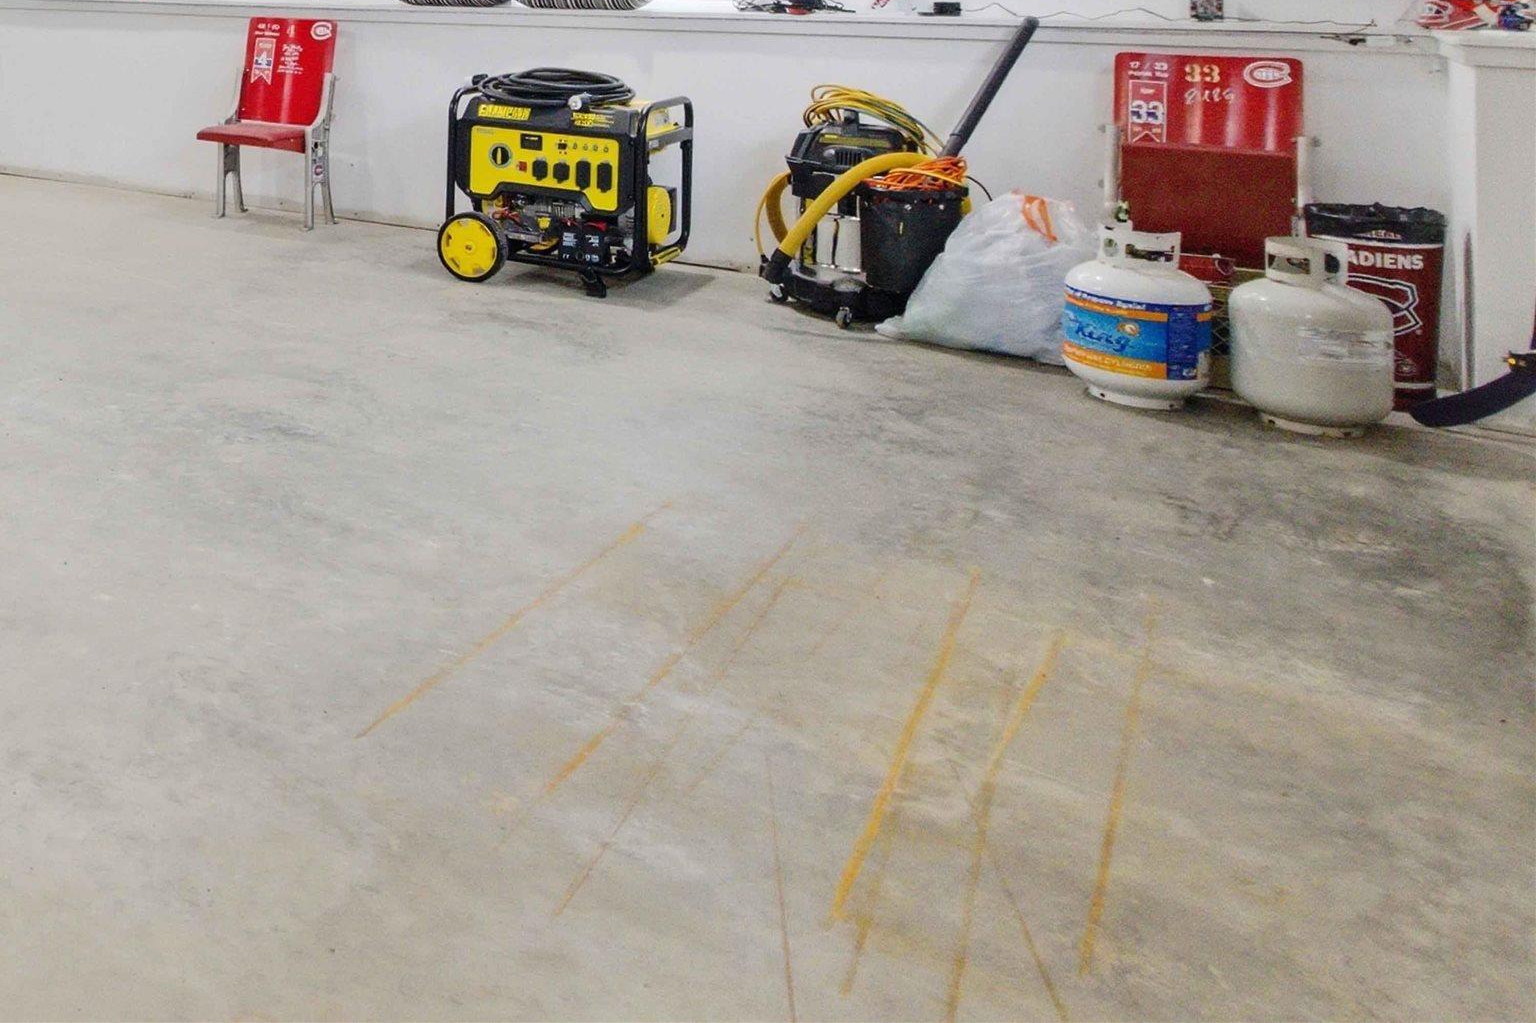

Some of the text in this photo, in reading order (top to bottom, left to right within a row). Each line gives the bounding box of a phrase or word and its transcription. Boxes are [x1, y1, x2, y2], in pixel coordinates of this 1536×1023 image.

[1184, 63, 1221, 84] 33
[1130, 100, 1164, 125] 33
[1348, 250, 1424, 270] ADIENS
